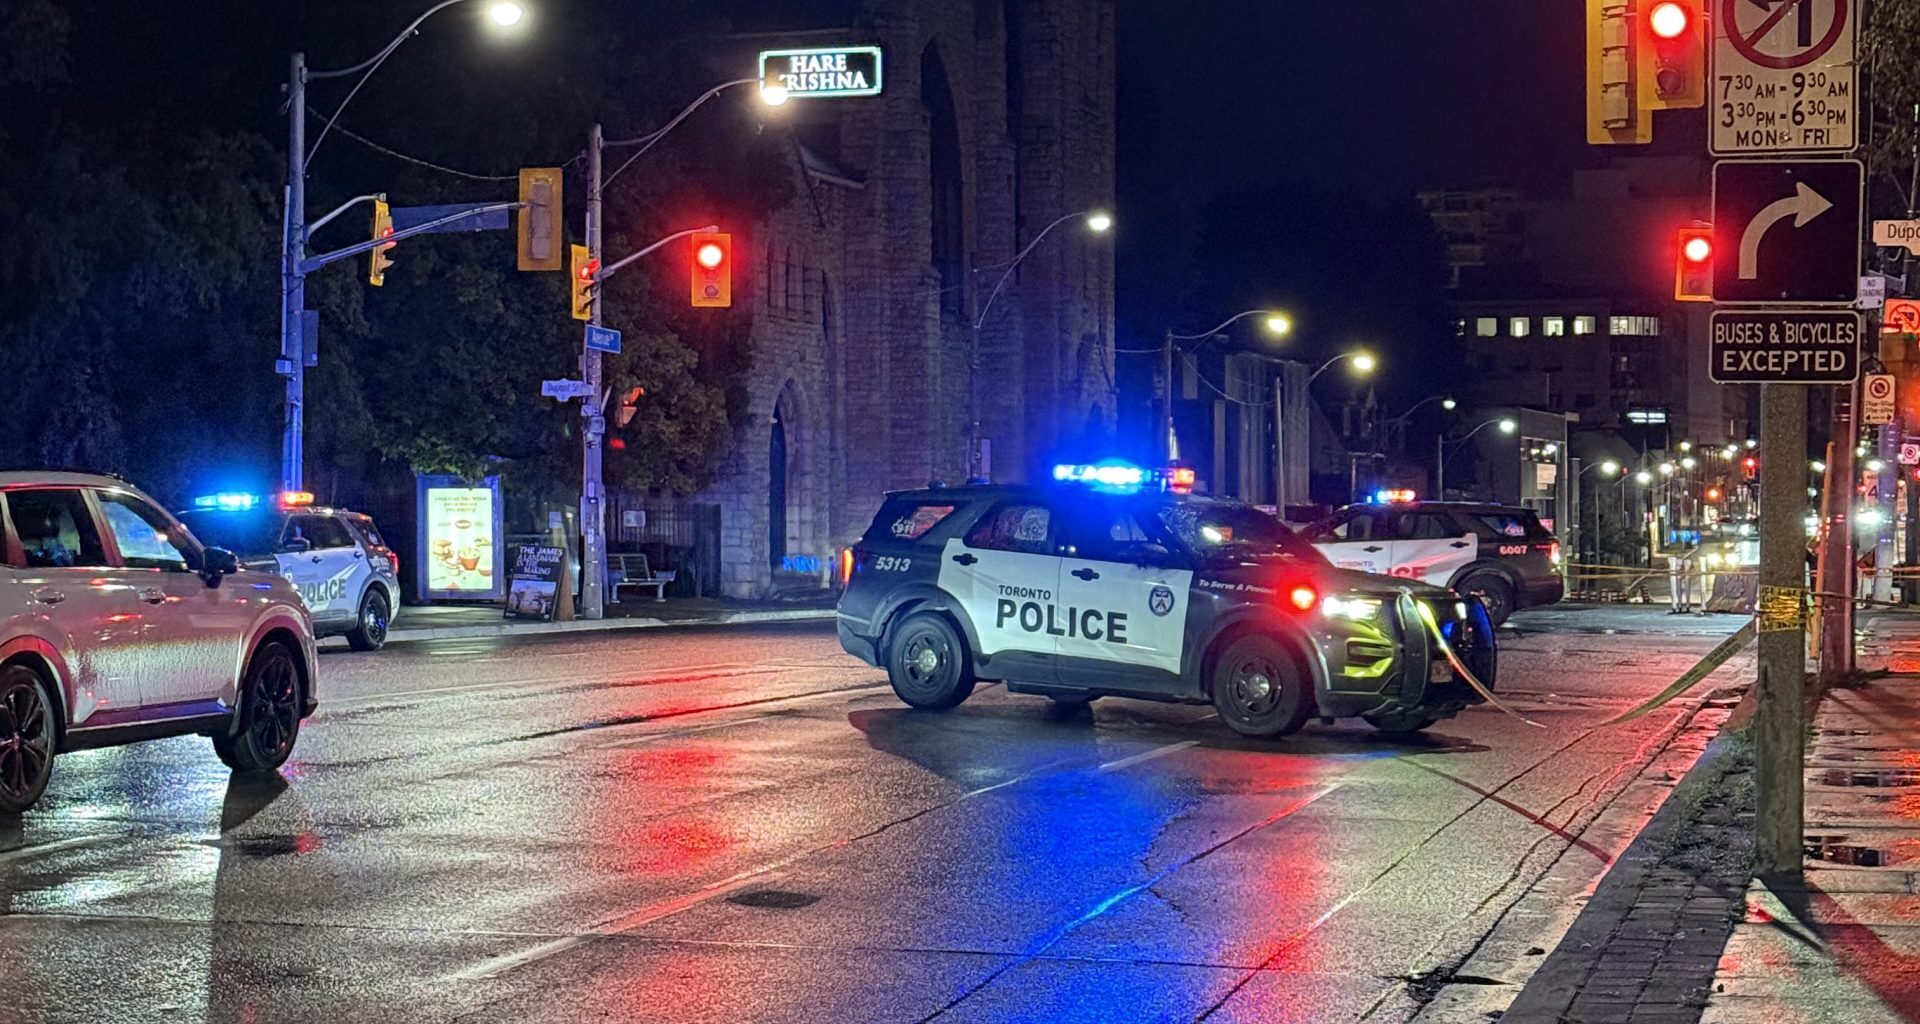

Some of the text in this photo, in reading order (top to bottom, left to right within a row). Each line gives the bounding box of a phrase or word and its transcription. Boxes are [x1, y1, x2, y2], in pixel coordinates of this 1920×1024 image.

[790, 54, 848, 73] HARE
[779, 71, 869, 90] RISHNA
[1736, 130, 1777, 147] MON
[1803, 129, 1830, 144] FRI
[1715, 322, 1855, 344] BUSES & BICYCLES
[1722, 350, 1846, 372] EXCEPTED
[1868, 485, 1879, 498] 4
[520, 546, 563, 556] THE JAMES
[875, 556, 911, 571] 5313
[998, 584, 1051, 600] TORONTO
[1210, 580, 1234, 590] Serve
[996, 598, 1128, 644] POLICE
